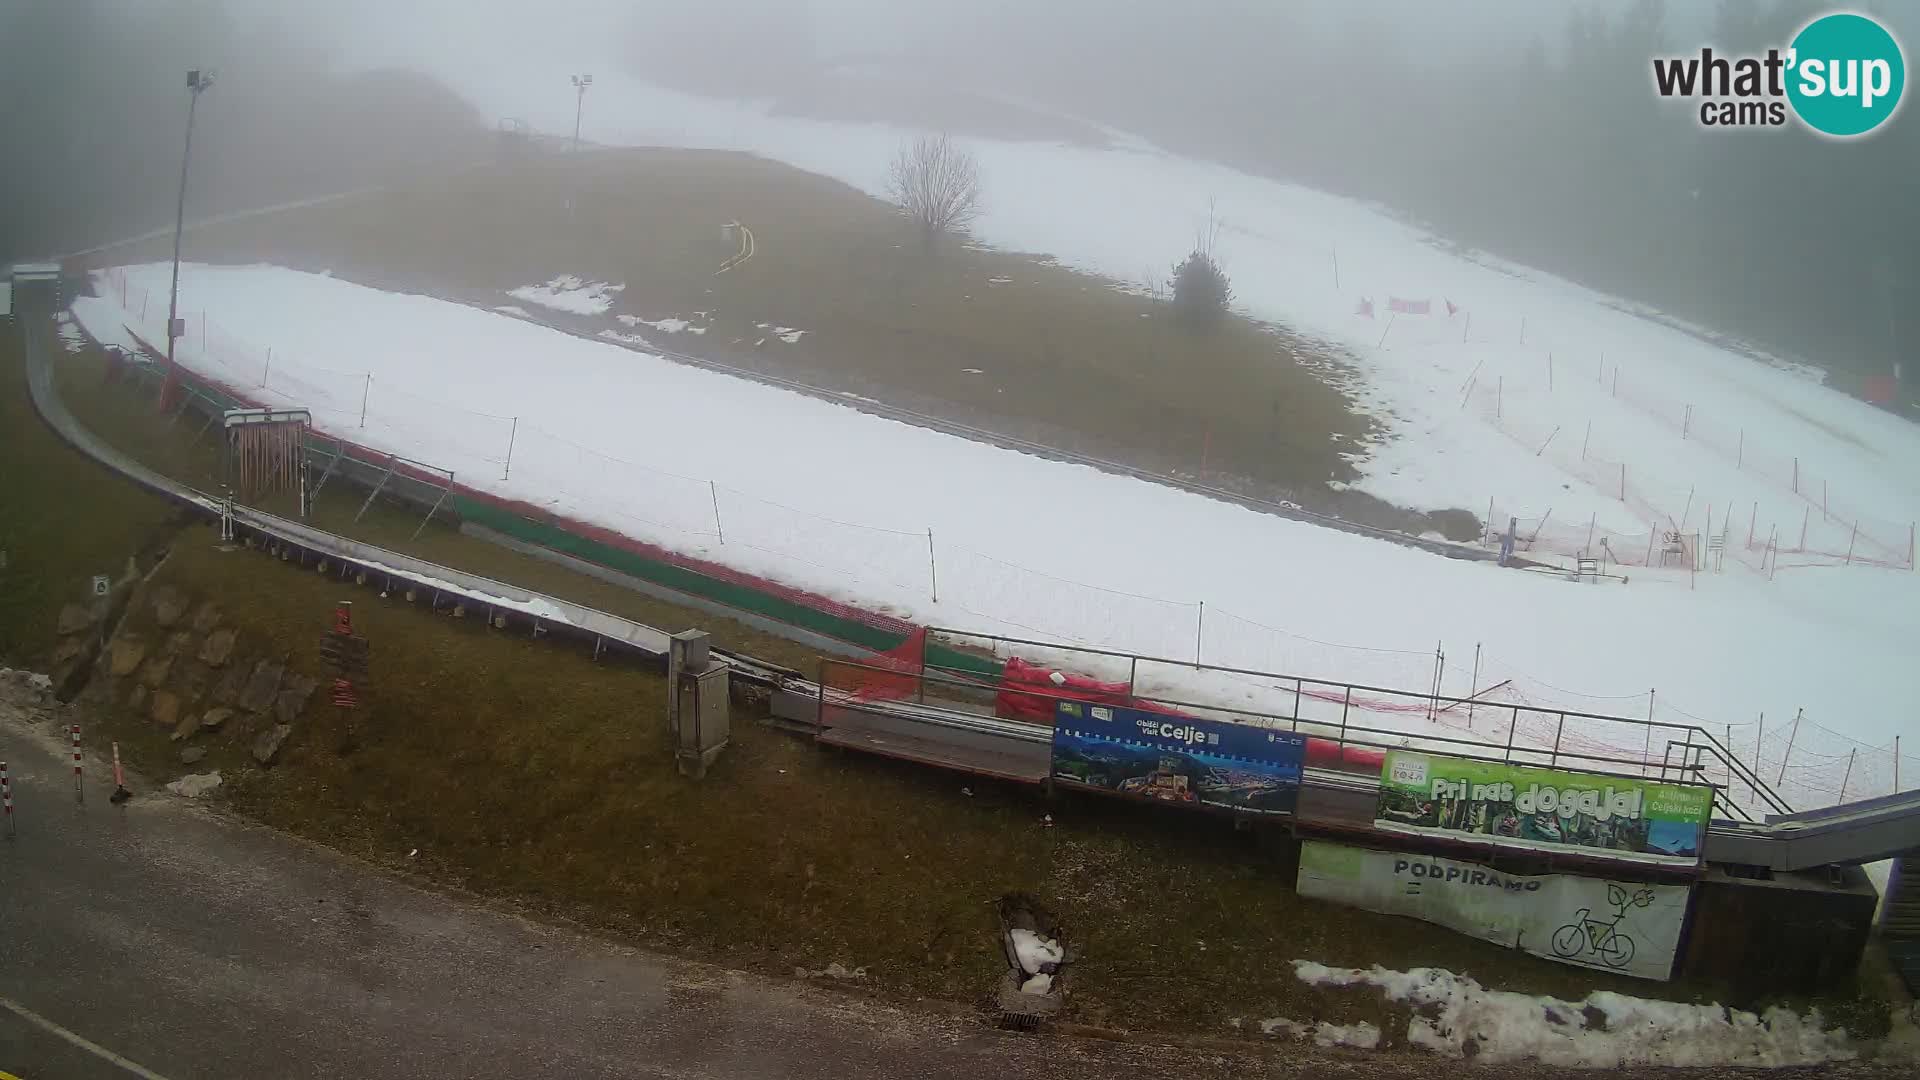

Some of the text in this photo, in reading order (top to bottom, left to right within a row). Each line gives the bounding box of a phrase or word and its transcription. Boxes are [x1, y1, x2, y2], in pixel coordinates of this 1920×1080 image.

[1142, 723, 1205, 745] Visit Celje
[1431, 777, 1468, 801] Pri
[1471, 782, 1514, 802] nas
[1515, 783, 1642, 821] dogaja!
[1394, 860, 1541, 892] PODPIRAMO
